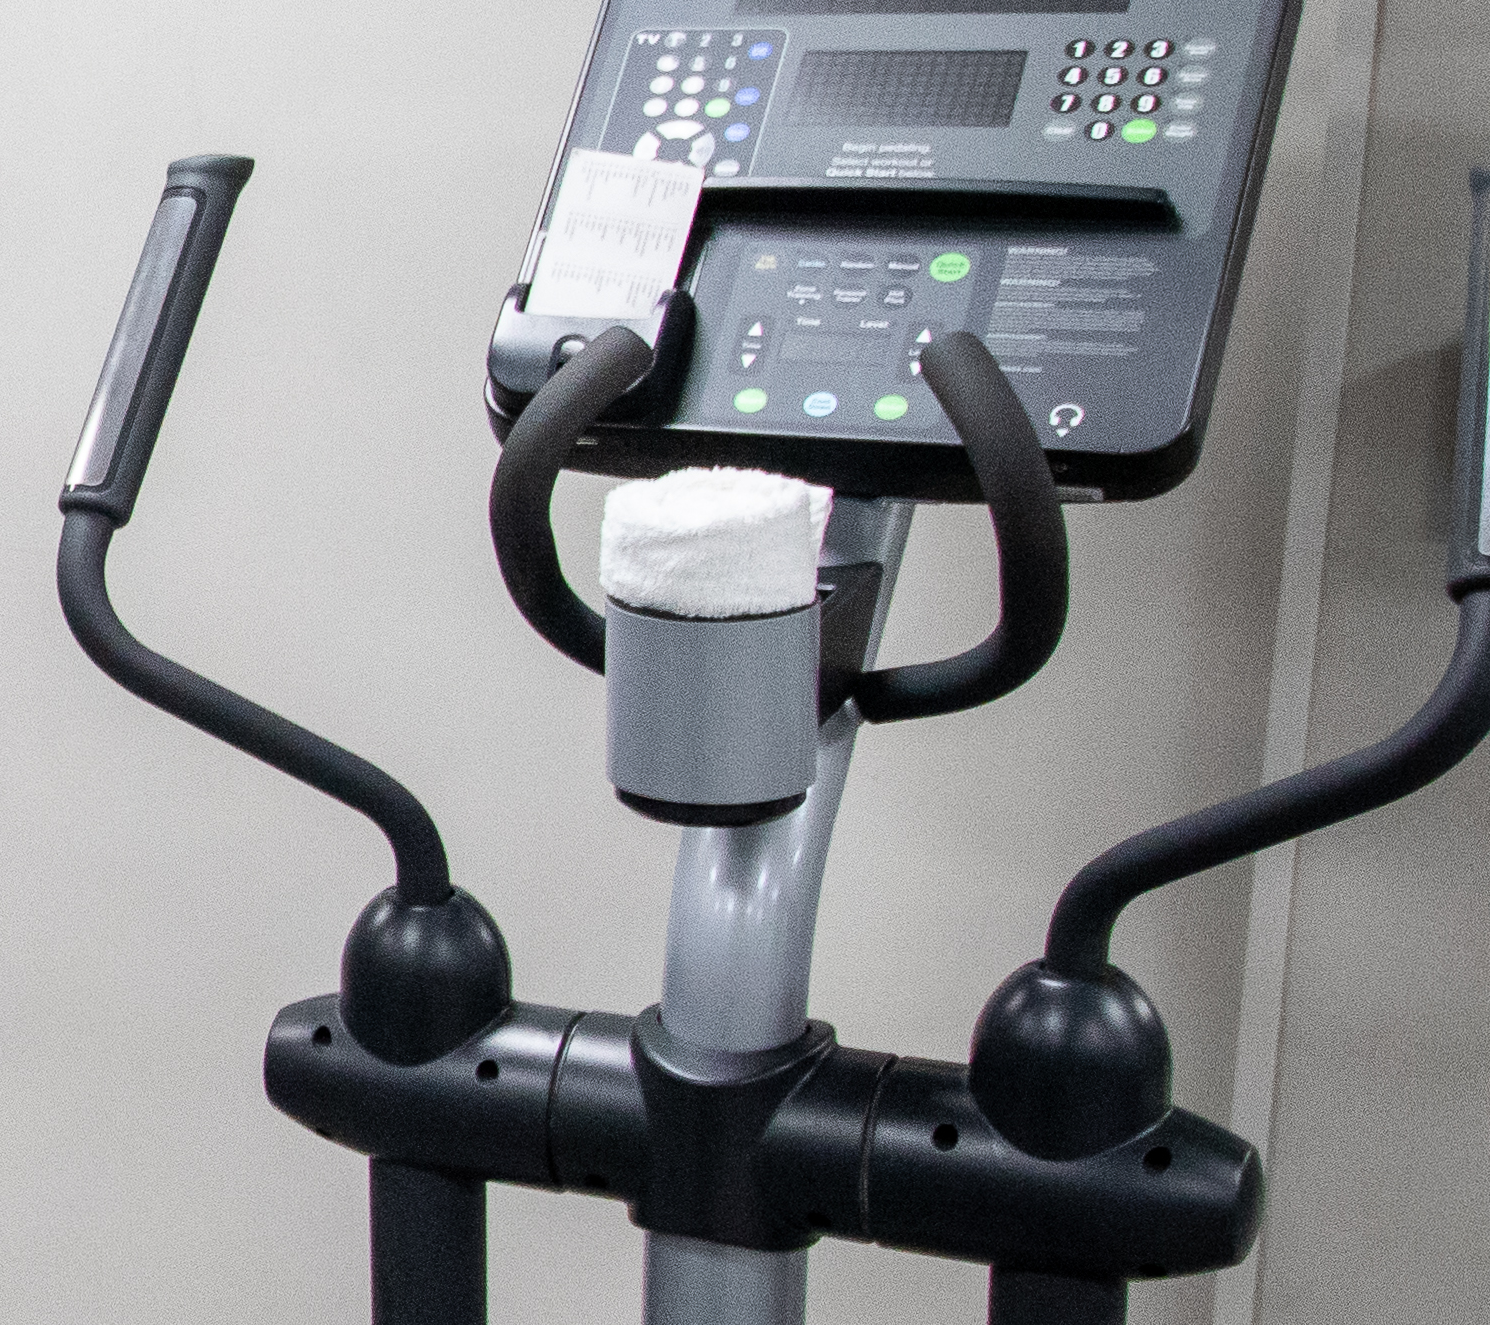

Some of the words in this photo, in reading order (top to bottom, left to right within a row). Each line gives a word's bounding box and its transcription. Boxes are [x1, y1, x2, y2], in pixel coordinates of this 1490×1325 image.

[636, 33, 661, 45] TV
[1073, 40, 1087, 57] 1
[1110, 40, 1128, 58] 2
[1150, 40, 1168, 58] 3
[1064, 67, 1082, 85] 4
[1104, 67, 1122, 85] 5
[1144, 67, 1162, 85] 6
[1061, 94, 1076, 111] 7
[1097, 94, 1115, 112] 8
[1137, 94, 1156, 112] 9
[842, 142, 876, 154] Begin
[825, 167, 862, 177] Quick
[865, 167, 897, 177] Start
[796, 317, 821, 326] Time
[860, 319, 890, 329] Level
